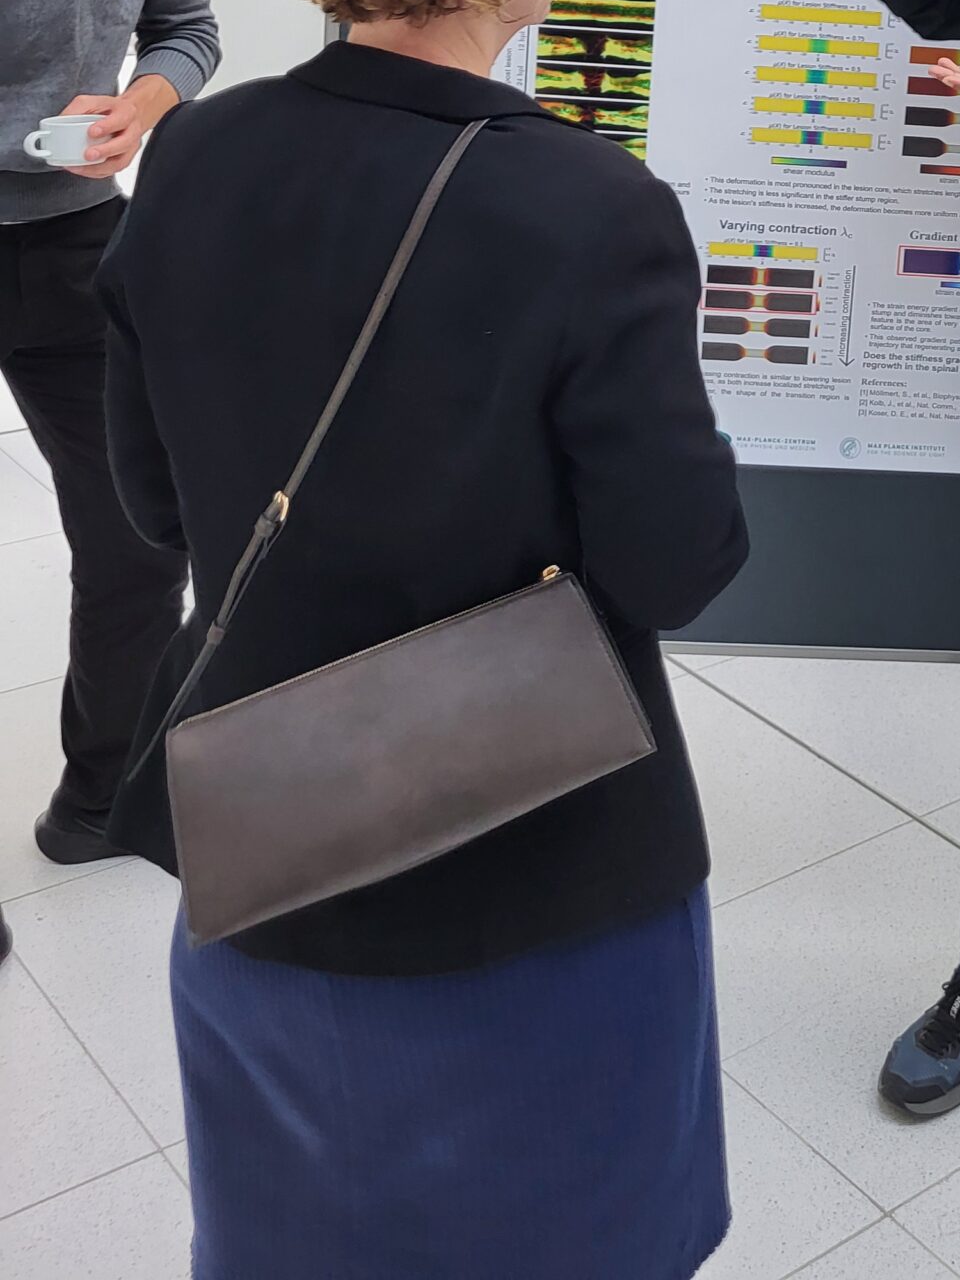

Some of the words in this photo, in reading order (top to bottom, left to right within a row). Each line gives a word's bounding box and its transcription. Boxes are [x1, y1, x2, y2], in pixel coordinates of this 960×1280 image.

[720, 220, 765, 234] Varying
[768, 224, 836, 235] contraction
[910, 230, 957, 242] Gradient
[842, 269, 852, 313] contraction
[838, 315, 849, 357] Increasing
[863, 351, 886, 359] Does
[905, 354, 943, 362] stiffness
[904, 362, 913, 370] in
[915, 363, 929, 371] the
[932, 364, 958, 372] spinal
[861, 378, 907, 388] References:
